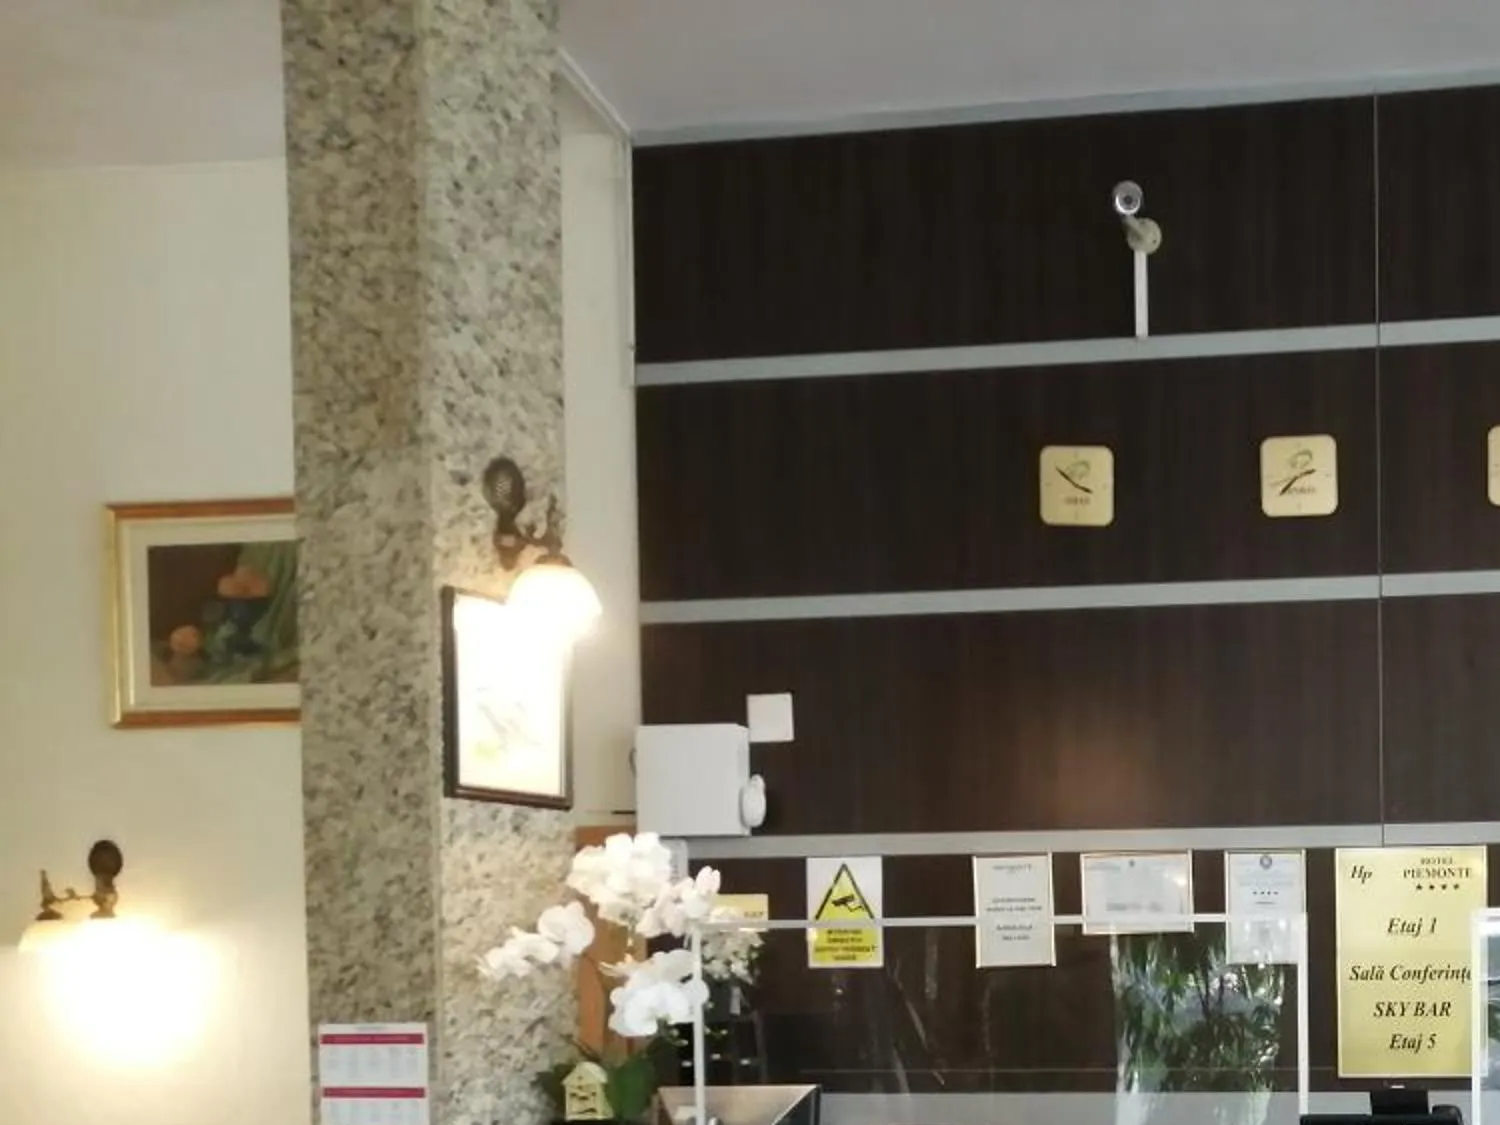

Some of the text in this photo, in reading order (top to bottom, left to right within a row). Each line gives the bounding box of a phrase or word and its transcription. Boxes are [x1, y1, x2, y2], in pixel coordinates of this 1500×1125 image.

[1420, 856, 1453, 865] HOTEL
[1403, 867, 1473, 879] PIEMONTE
[1388, 917, 1423, 938] Etaj
[1373, 1001, 1451, 1017] SKY BAR
[1389, 1033, 1438, 1054] Etaj 5
